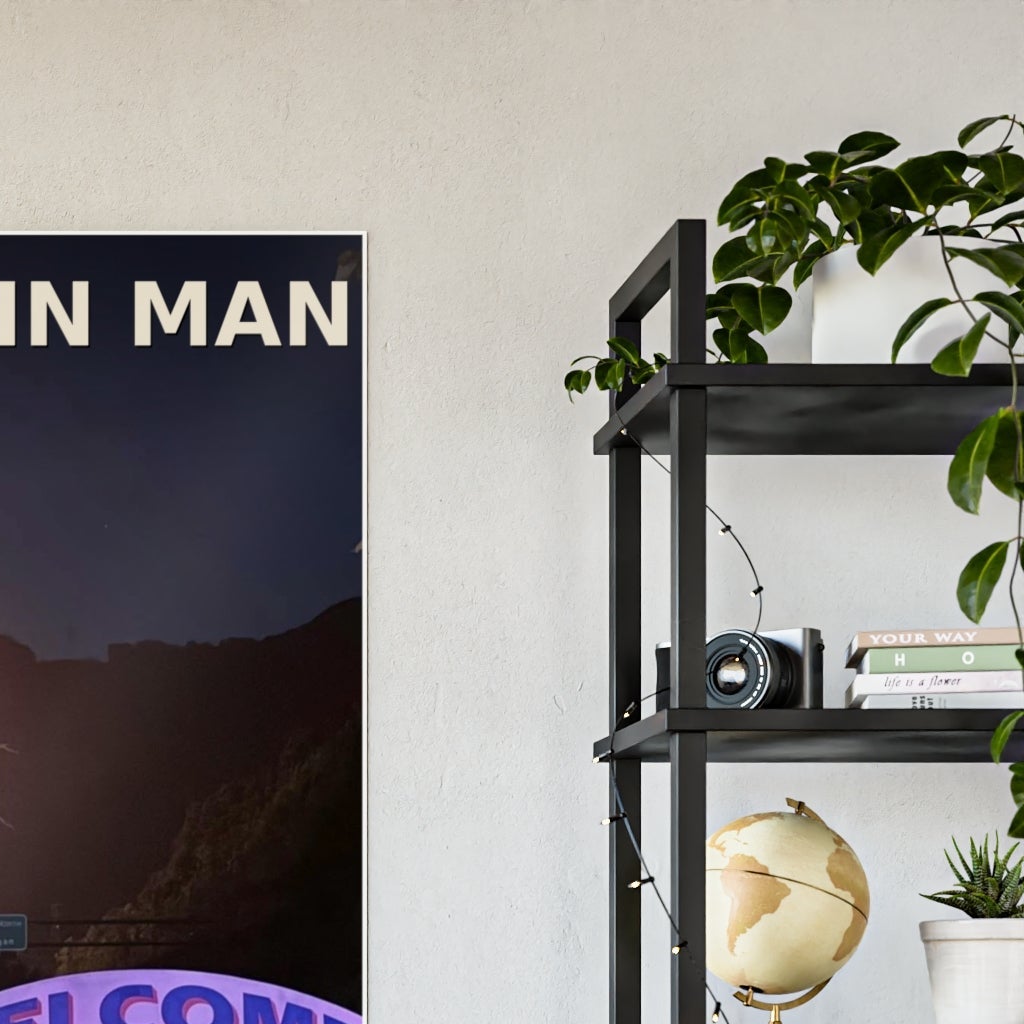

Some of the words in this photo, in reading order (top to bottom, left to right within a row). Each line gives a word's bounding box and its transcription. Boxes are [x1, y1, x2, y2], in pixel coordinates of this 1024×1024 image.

[134, 280, 348, 347] MAN
[870, 634, 927, 644] YOUR
[935, 632, 977, 642] WAY
[895, 653, 905, 666] H
[884, 676, 901, 692] life
[905, 678, 914, 687] is
[918, 677, 925, 686] a
[928, 675, 962, 690] flower
